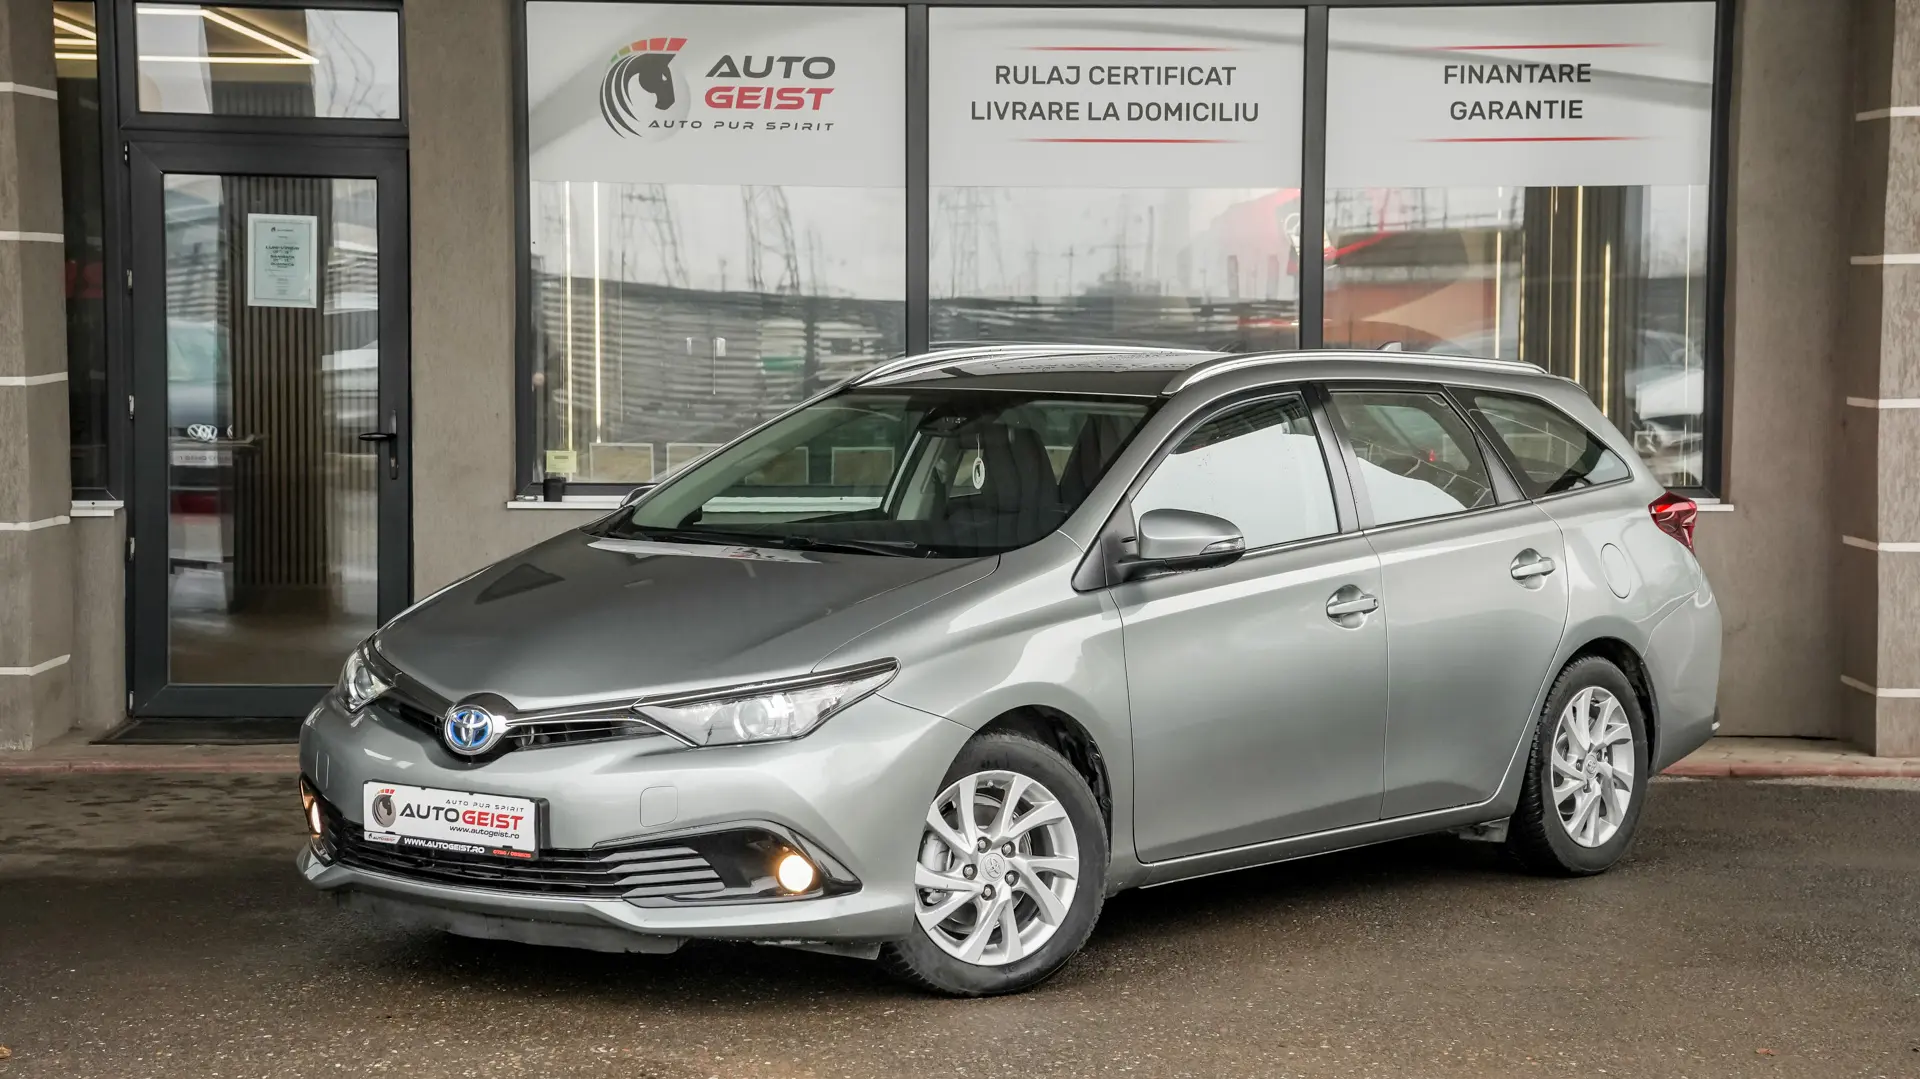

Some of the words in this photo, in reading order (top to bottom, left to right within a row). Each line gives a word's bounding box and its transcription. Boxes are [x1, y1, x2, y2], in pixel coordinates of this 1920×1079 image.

[705, 54, 836, 80] AUTO
[995, 65, 1081, 85] RULAJ
[1088, 65, 1237, 86] CERTIFICAT
[1444, 63, 1592, 85] FINANTARE
[704, 86, 835, 111] GEIST
[971, 101, 1080, 121] LIVRARE
[1087, 101, 1121, 121] LA
[1127, 102, 1259, 122] DOMICILIU
[1450, 100, 1584, 121] GARANTIE
[648, 119, 702, 129] AUTO
[713, 121, 754, 130] PUR
[765, 121, 835, 131] SPIRIT
[445, 798, 469, 807] AUTO
[472, 801, 491, 809] PUR
[494, 804, 525, 813] SPIRIT
[449, 825, 520, 840] www.autogeist.ro
[403, 837, 486, 855] WWW.AUTOGEIST.RO
